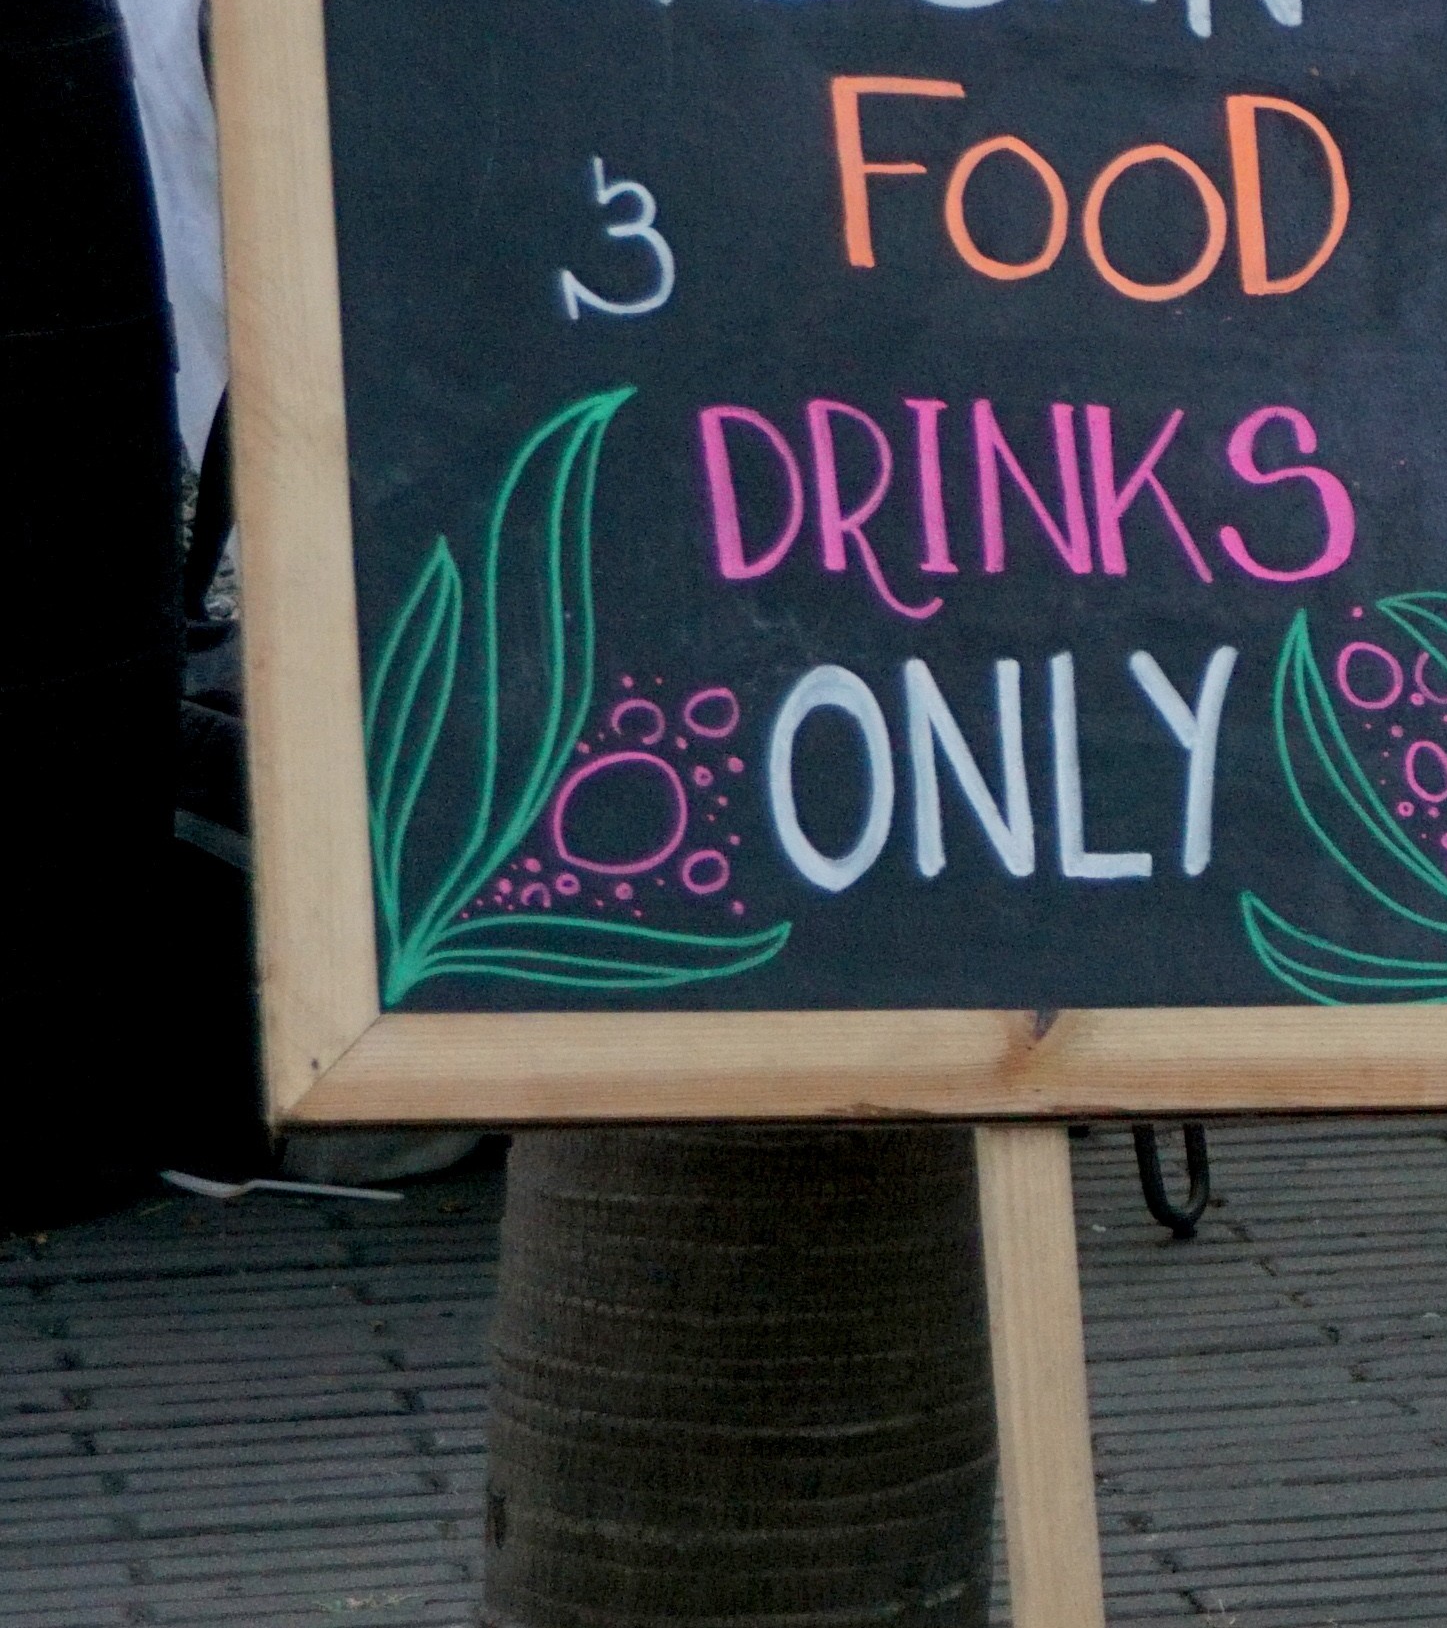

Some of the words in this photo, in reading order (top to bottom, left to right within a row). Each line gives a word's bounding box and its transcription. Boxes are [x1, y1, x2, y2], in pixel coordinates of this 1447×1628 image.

[834, 77, 1349, 298] FOOD
[701, 398, 1358, 617] DRINKS
[770, 646, 1236, 892] ONLY
